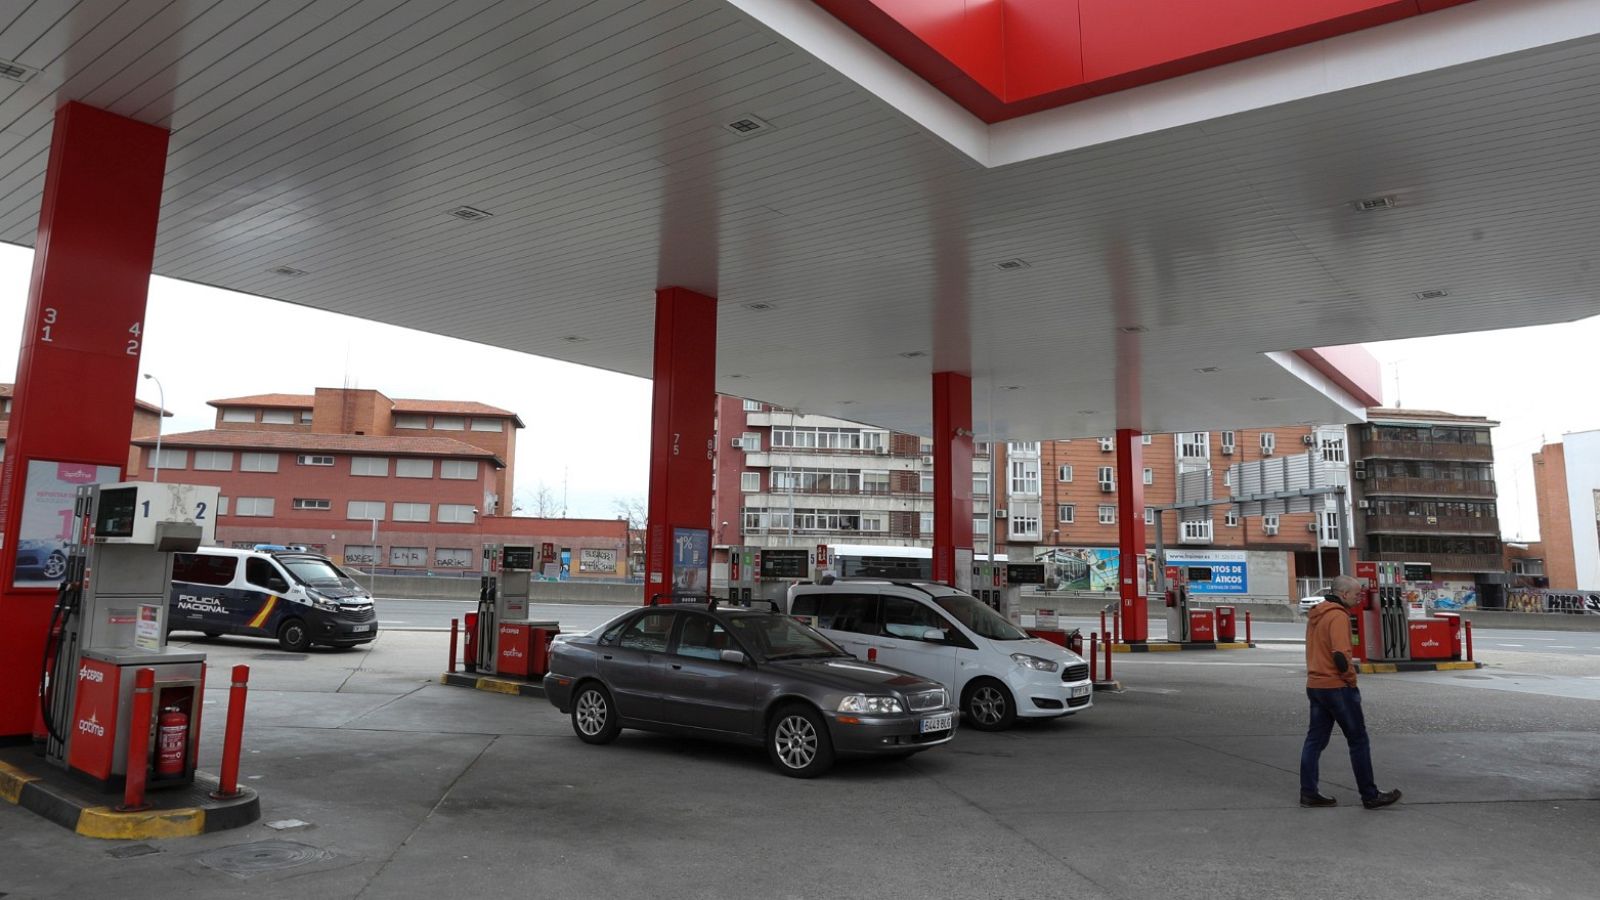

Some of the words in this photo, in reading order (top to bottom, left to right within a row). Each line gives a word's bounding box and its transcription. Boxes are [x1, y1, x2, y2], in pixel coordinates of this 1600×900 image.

[44, 308, 57, 324] 3
[41, 325, 53, 342] 1
[128, 322, 141, 337] 4
[126, 339, 139, 356] 2
[673, 433, 681, 444] 7
[707, 439, 713, 450] 8
[673, 444, 680, 456] 5
[706, 450, 713, 460] 6
[141, 500, 150, 518] 1
[195, 502, 207, 520] 2
[810, 554, 816, 565] 5
[828, 554, 834, 565] 6
[1231, 565, 1242, 573] DE
[1215, 573, 1242, 583] ÁTICOS
[177, 602, 230, 614] NACIONAL
[79, 719, 105, 737] optima
